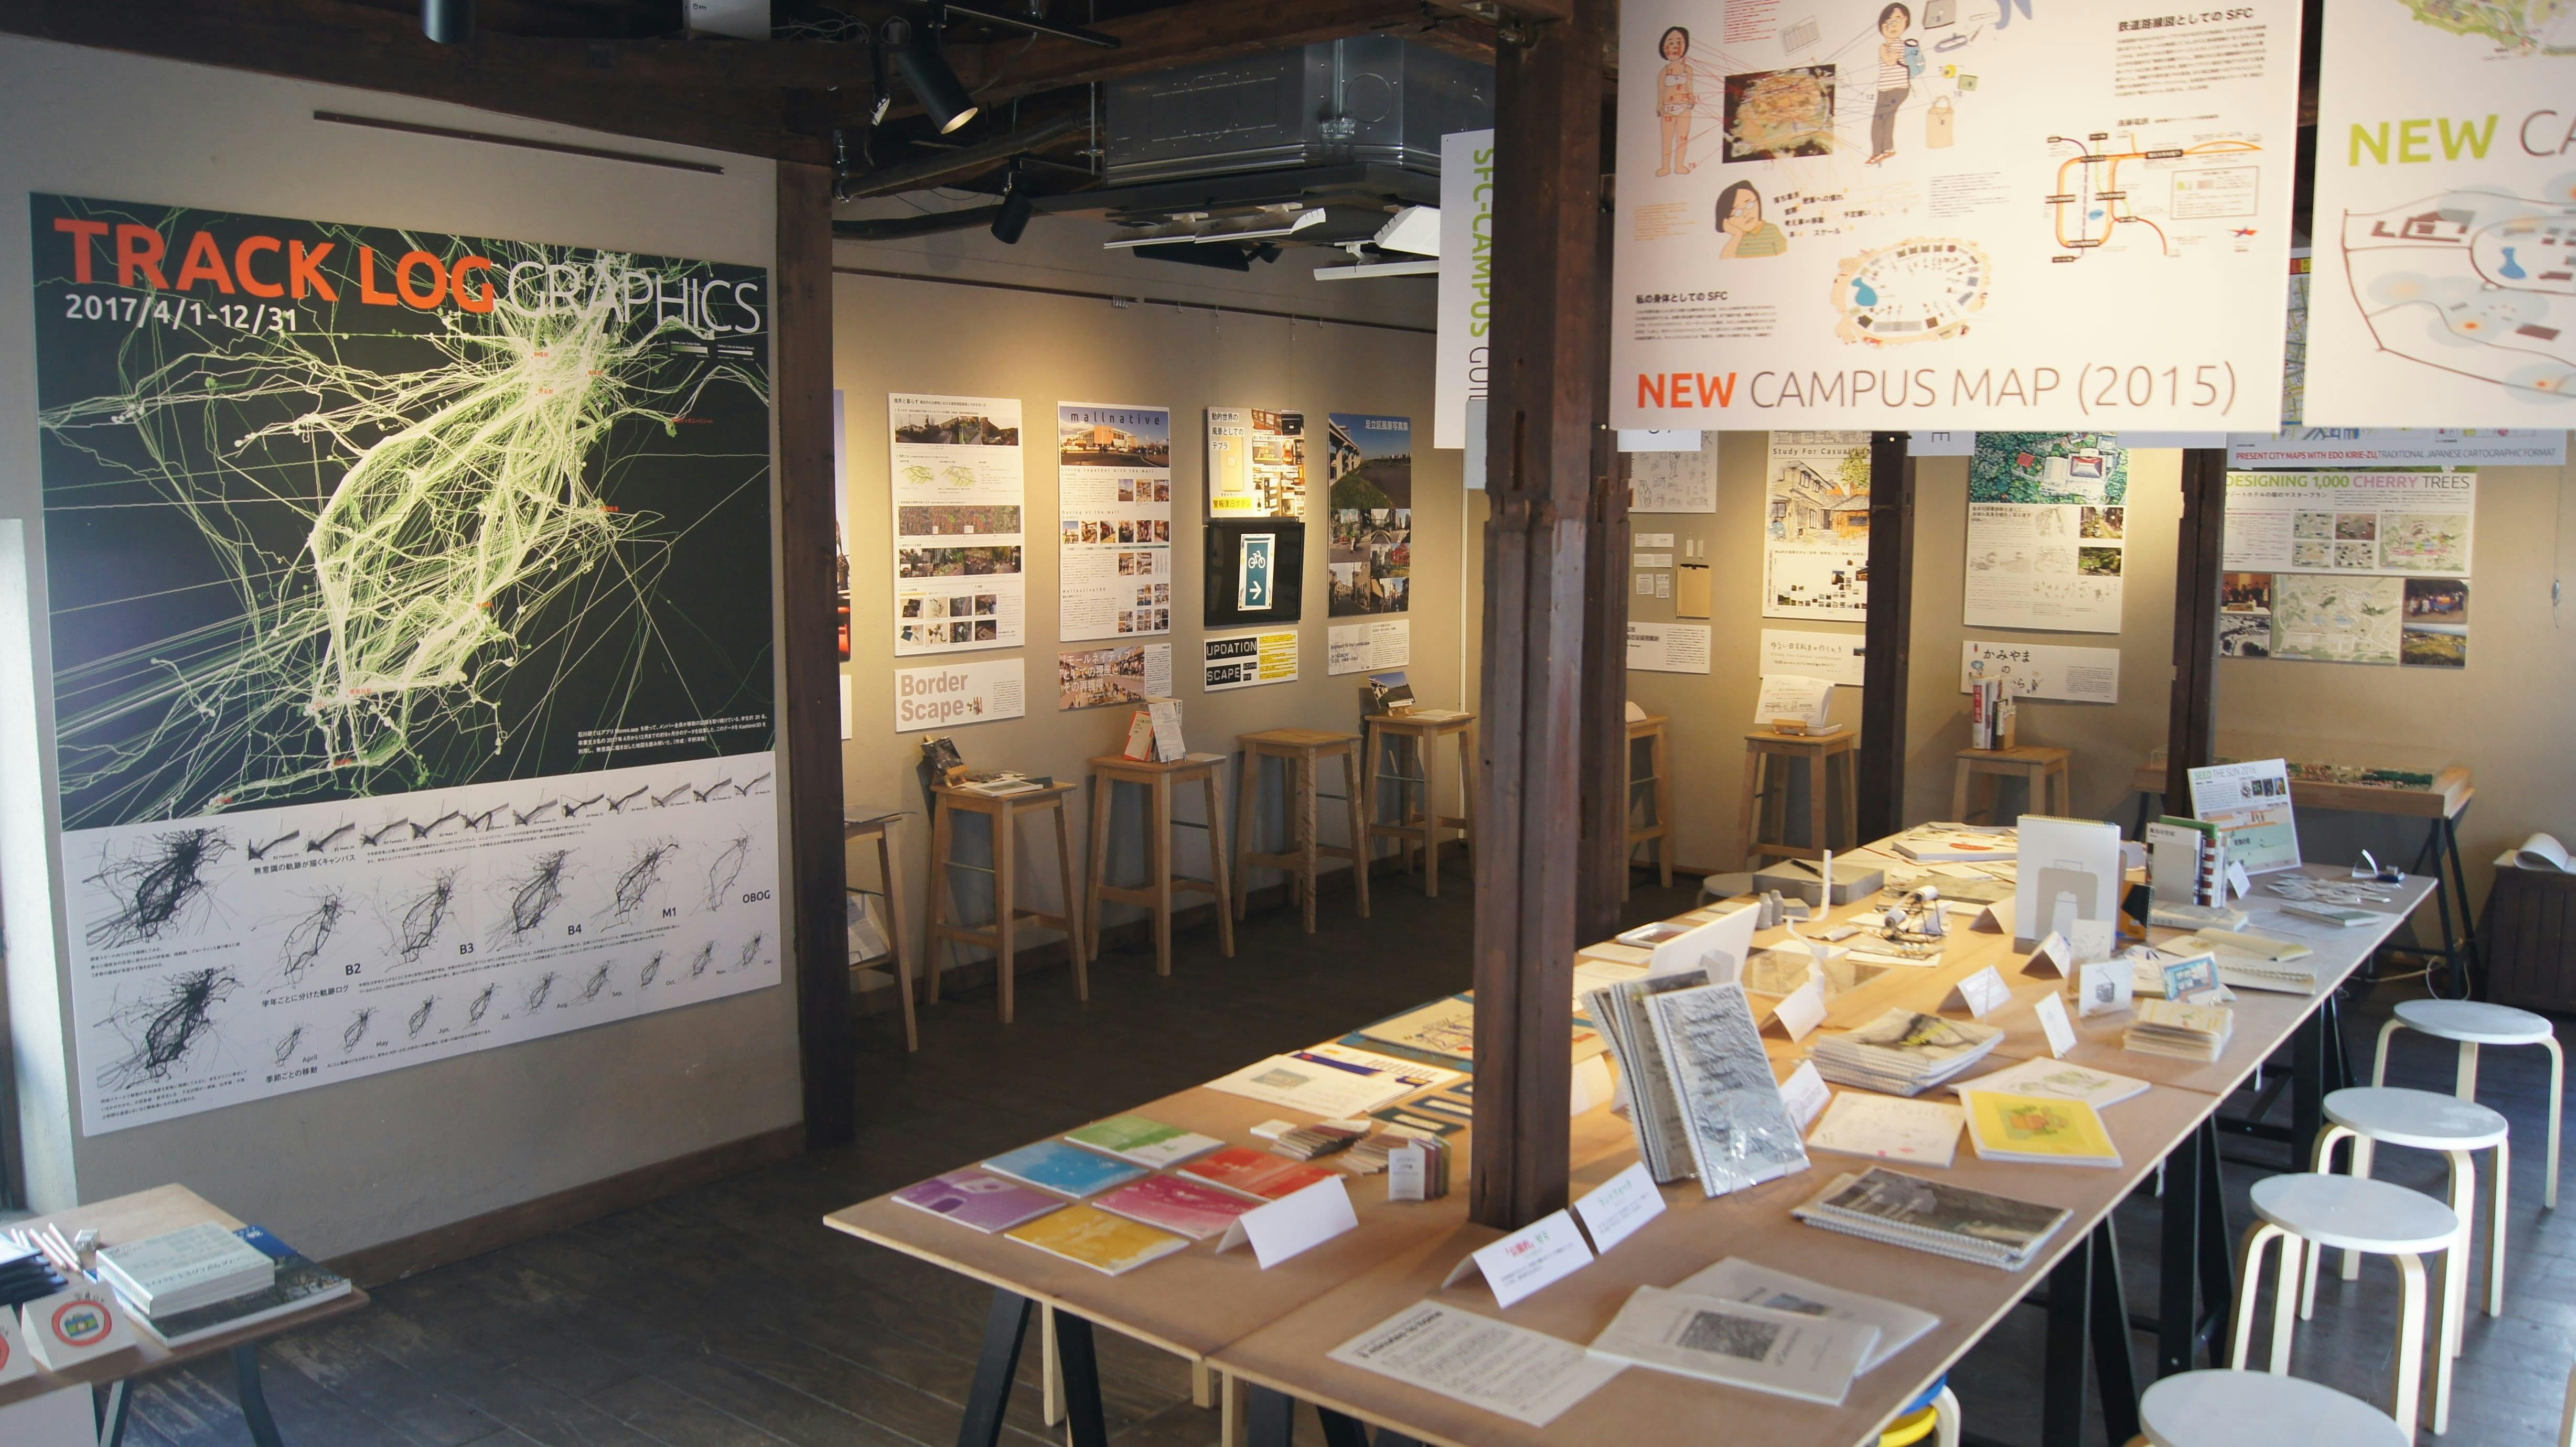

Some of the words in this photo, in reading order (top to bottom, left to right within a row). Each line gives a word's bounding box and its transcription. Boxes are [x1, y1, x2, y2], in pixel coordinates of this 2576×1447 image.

[2226, 8, 2253, 20] SFC
[2348, 114, 2499, 167] NEW
[53, 218, 338, 302] TRACK
[359, 246, 495, 313] LOG
[507, 260, 761, 334] GRAPHICS
[1708, 291, 1729, 301] SFC
[65, 294, 297, 334] 2017/4/1-12/31
[1637, 372, 1737, 408] NEW
[1751, 369, 1937, 408] CAMPUS
[1952, 368, 2060, 407] MAP
[2078, 361, 2236, 416] (2015)
[1071, 411, 1160, 425] mallnative
[1365, 419, 1409, 431] 足立区風景写真集
[1211, 427, 1244, 436] 風景としての
[2427, 448, 2463, 458] JAPANESE
[2464, 448, 2523, 458] CARTOGRAPHIC
[2524, 448, 2556, 457] FORMAT
[2227, 475, 2307, 487] DESIGNING
[2313, 476, 2349, 489] 1,000
[2353, 476, 2418, 488] CHERRY
[2422, 476, 2470, 489] TREES
[1207, 641, 1257, 656] UPDATION
[1983, 649, 2030, 663] かみやま
[1207, 667, 1240, 681] SCAPE
[2001, 665, 2011, 674] の
[900, 671, 968, 697] Border
[900, 699, 964, 723] Scape
[254, 854, 355, 875] 無意識の軌跡が描くキャンバス
[742, 890, 770, 904] OBOG
[662, 908, 677, 919] M1
[568, 925, 582, 936] B4
[459, 943, 474, 955] B3
[345, 964, 361, 976] B2
[262, 985, 349, 1008] 学年ごとに分けた軌跡ログ
[376, 1039, 389, 1049] May
[302, 1054, 318, 1064] April
[266, 1066, 318, 1084] 季節ごとの移動
